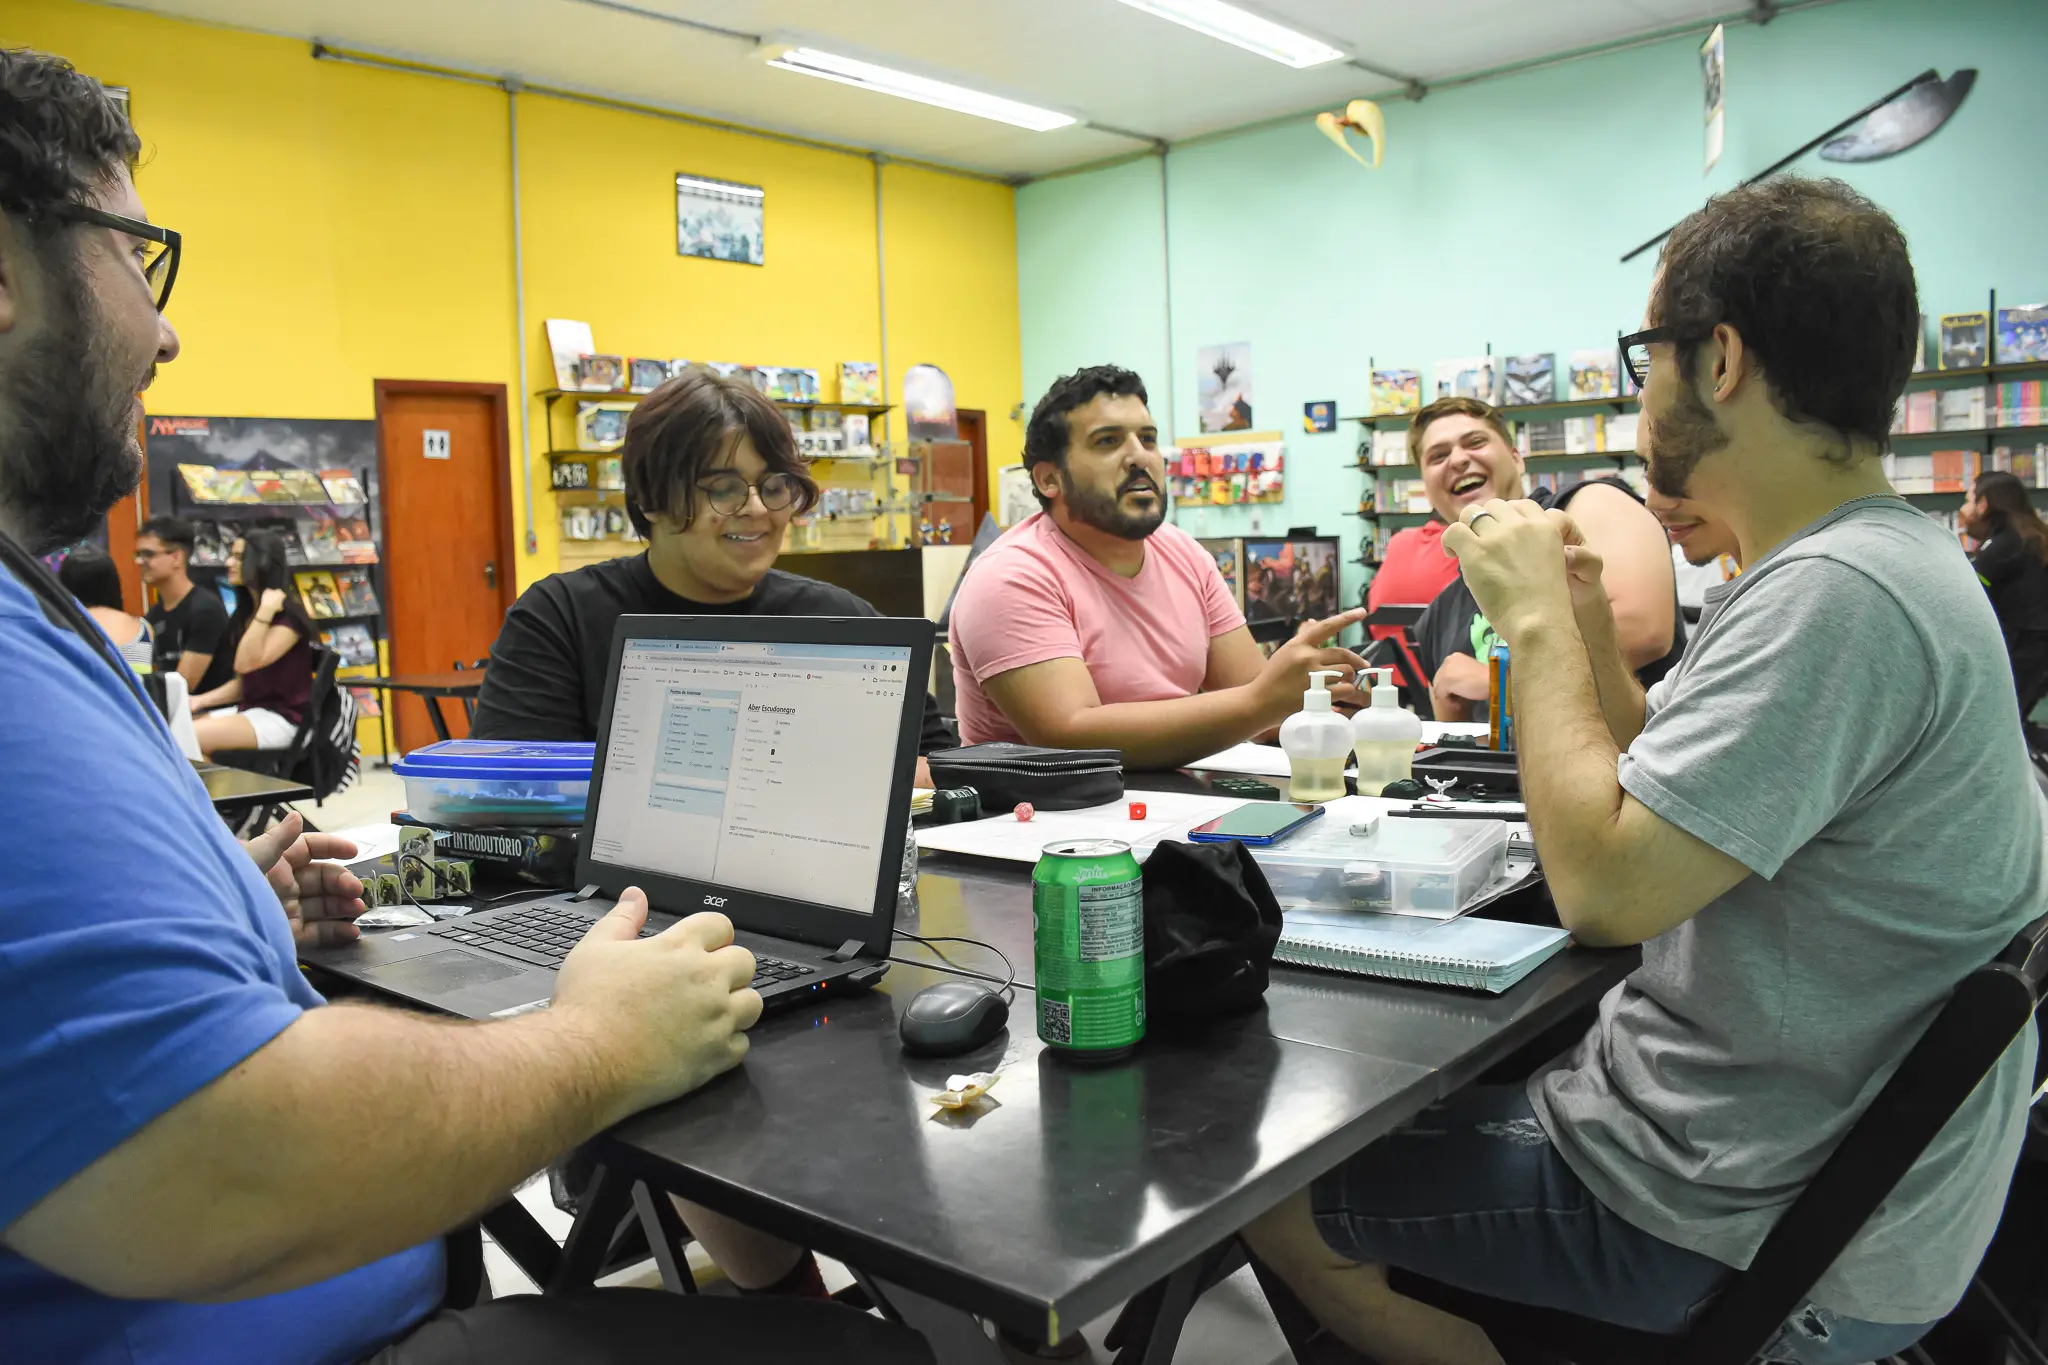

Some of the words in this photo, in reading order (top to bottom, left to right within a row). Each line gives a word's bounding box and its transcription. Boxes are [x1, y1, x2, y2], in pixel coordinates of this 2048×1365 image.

[453, 831, 522, 857] INTRODUTÓRIO
[1091, 881, 1131, 893] INFORMAÇÃO
[703, 894, 728, 907] acer
